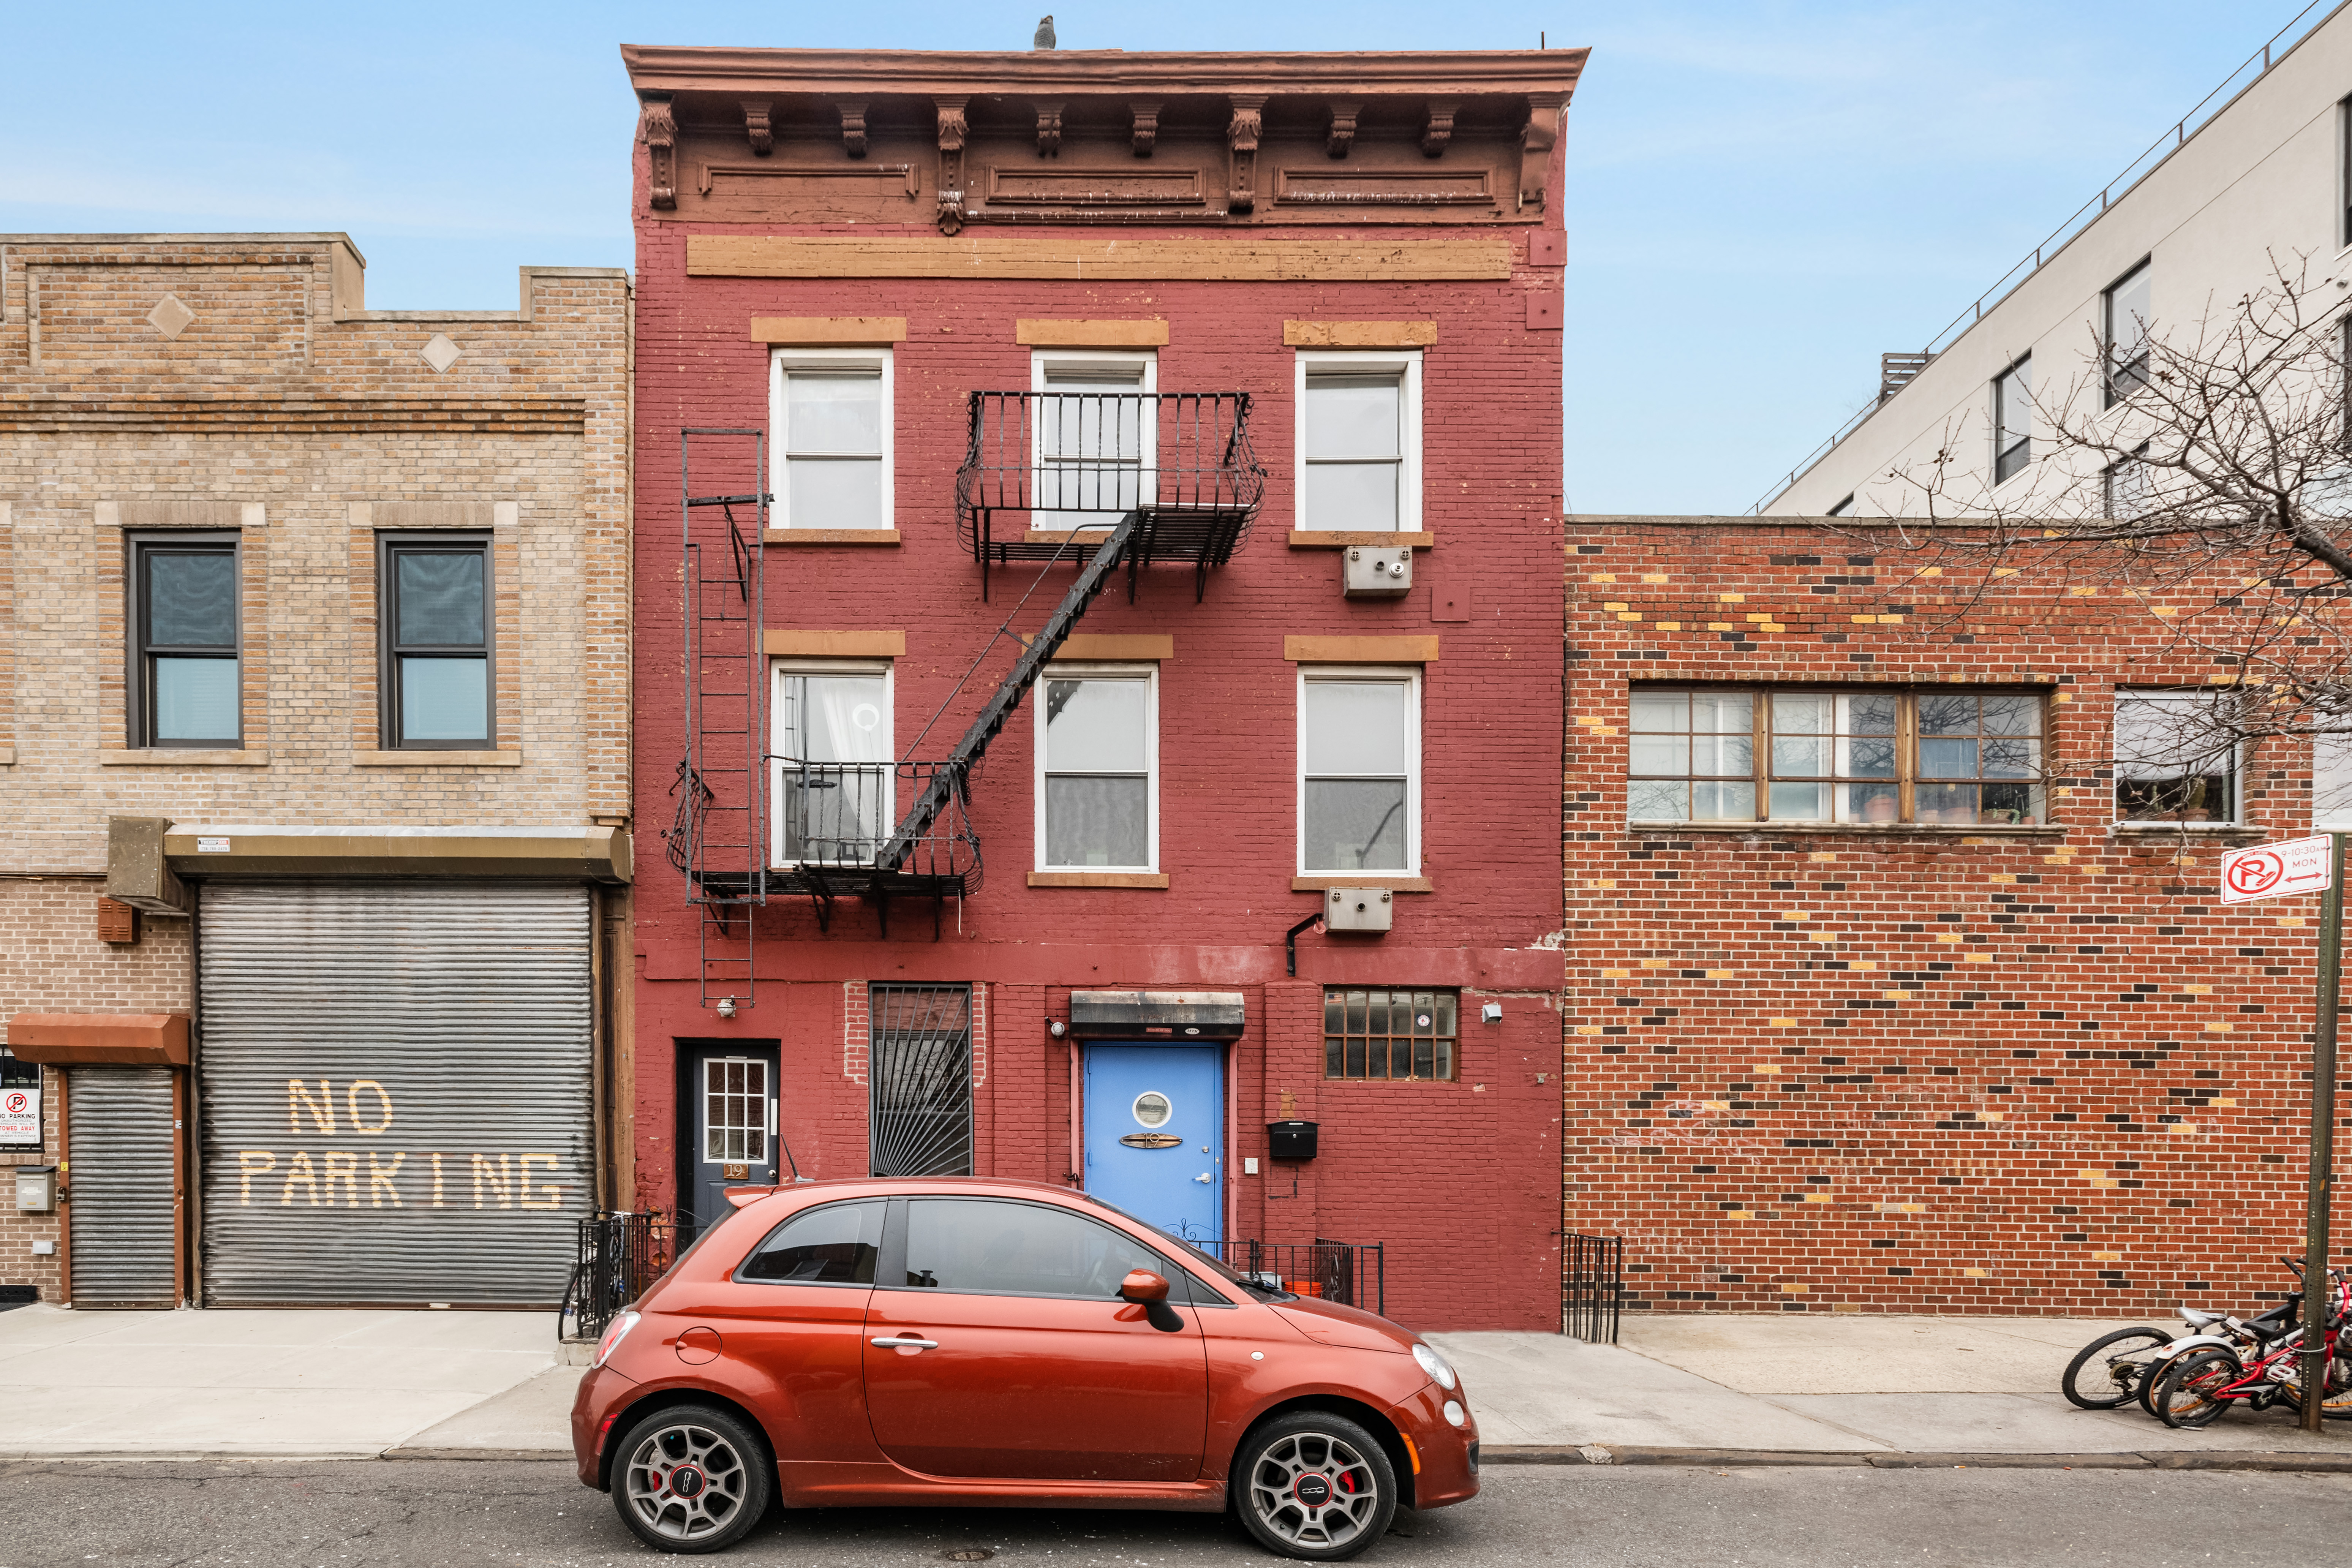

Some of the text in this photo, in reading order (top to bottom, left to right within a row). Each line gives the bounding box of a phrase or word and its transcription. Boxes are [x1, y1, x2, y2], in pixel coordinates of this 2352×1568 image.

[2292, 858, 2317, 868] MON
[288, 1079, 393, 1135] NO
[1144, 1133, 1159, 1148] 19
[726, 1164, 743, 1177] 19
[239, 1151, 560, 1209] PARKING
